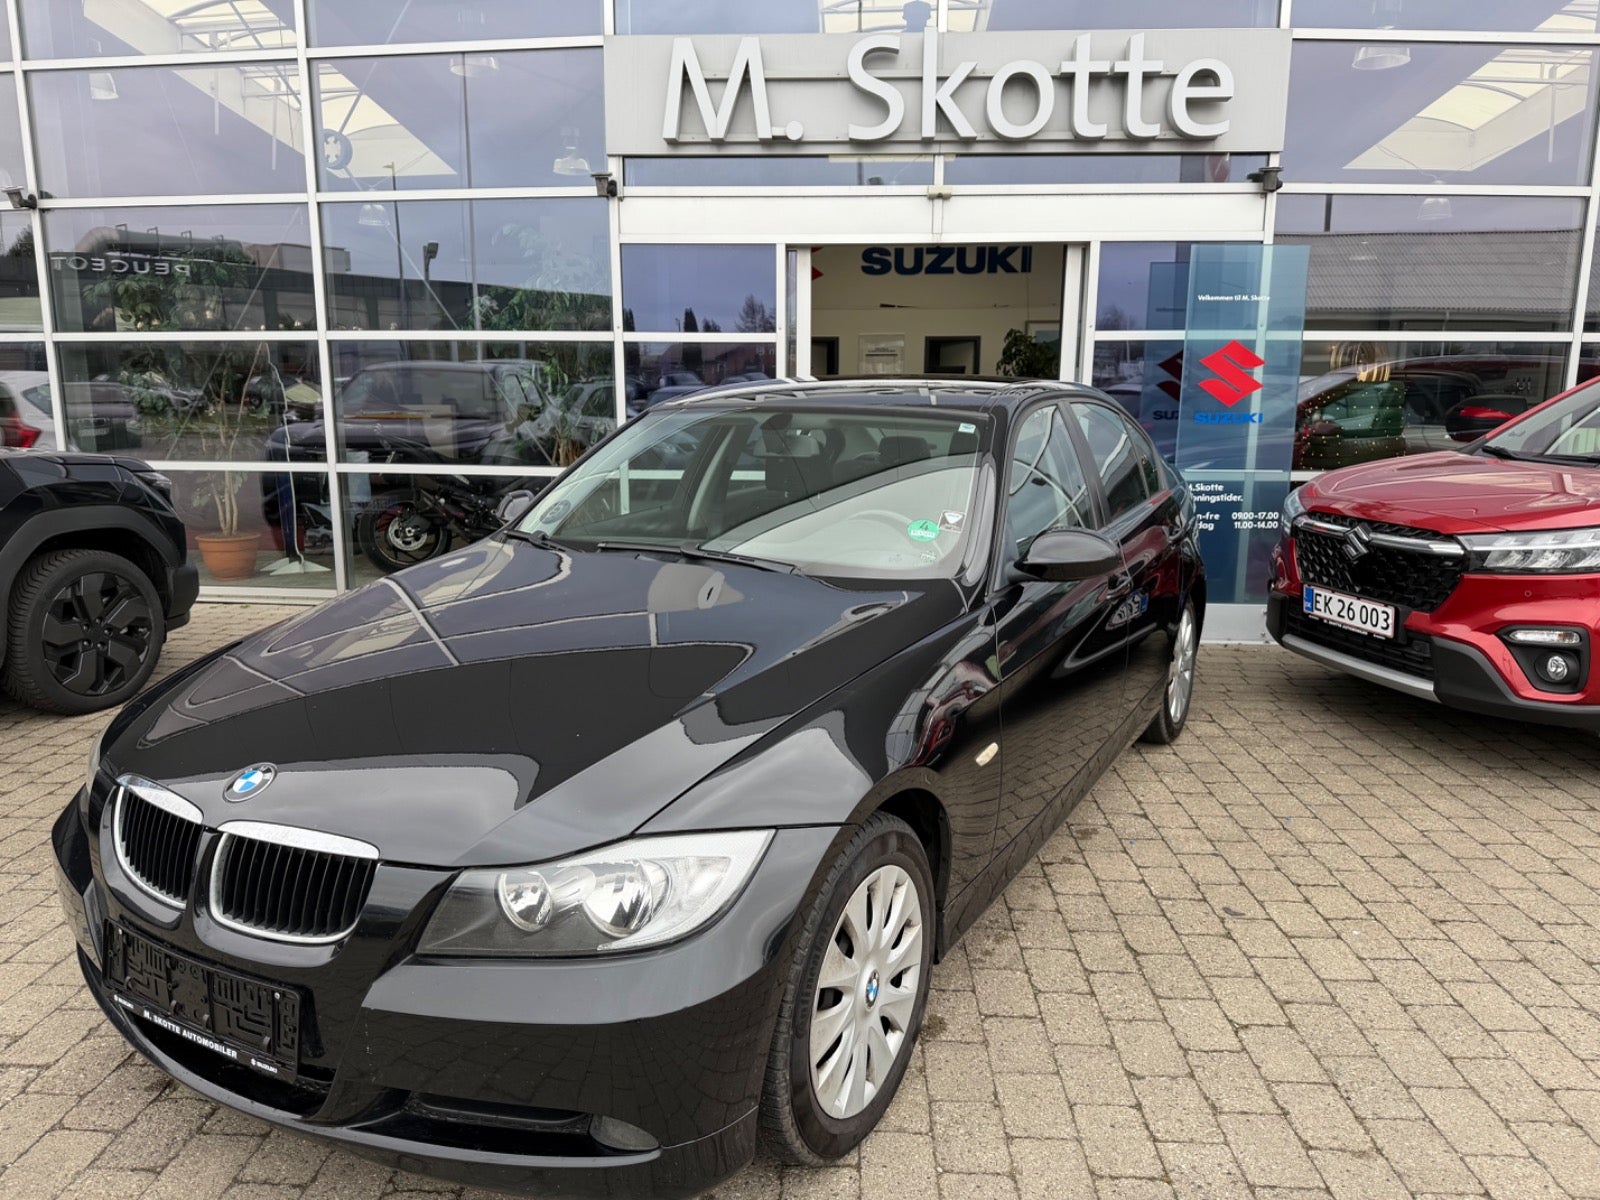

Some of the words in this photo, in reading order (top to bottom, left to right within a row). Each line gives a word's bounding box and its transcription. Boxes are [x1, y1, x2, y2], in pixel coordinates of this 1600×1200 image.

[662, 36, 804, 145] M.
[846, 26, 1236, 142] Skotte
[861, 245, 1033, 276] SUZUKI
[1198, 294, 1234, 302] Velkommen
[1234, 294, 1242, 302] til
[1251, 294, 1270, 302] Skotte
[1153, 410, 1179, 420] SU
[1195, 412, 1264, 424] SUZUKI
[1196, 512, 1220, 520] n-fre
[1198, 521, 1213, 530] dag
[1314, 593, 1332, 615] EK
[1337, 599, 1355, 620] 26
[1360, 605, 1389, 630] 003
[143, 1009, 152, 1021] M.
[154, 1014, 180, 1034] SKOTTE
[182, 1029, 238, 1060] AUTOMOBILER
